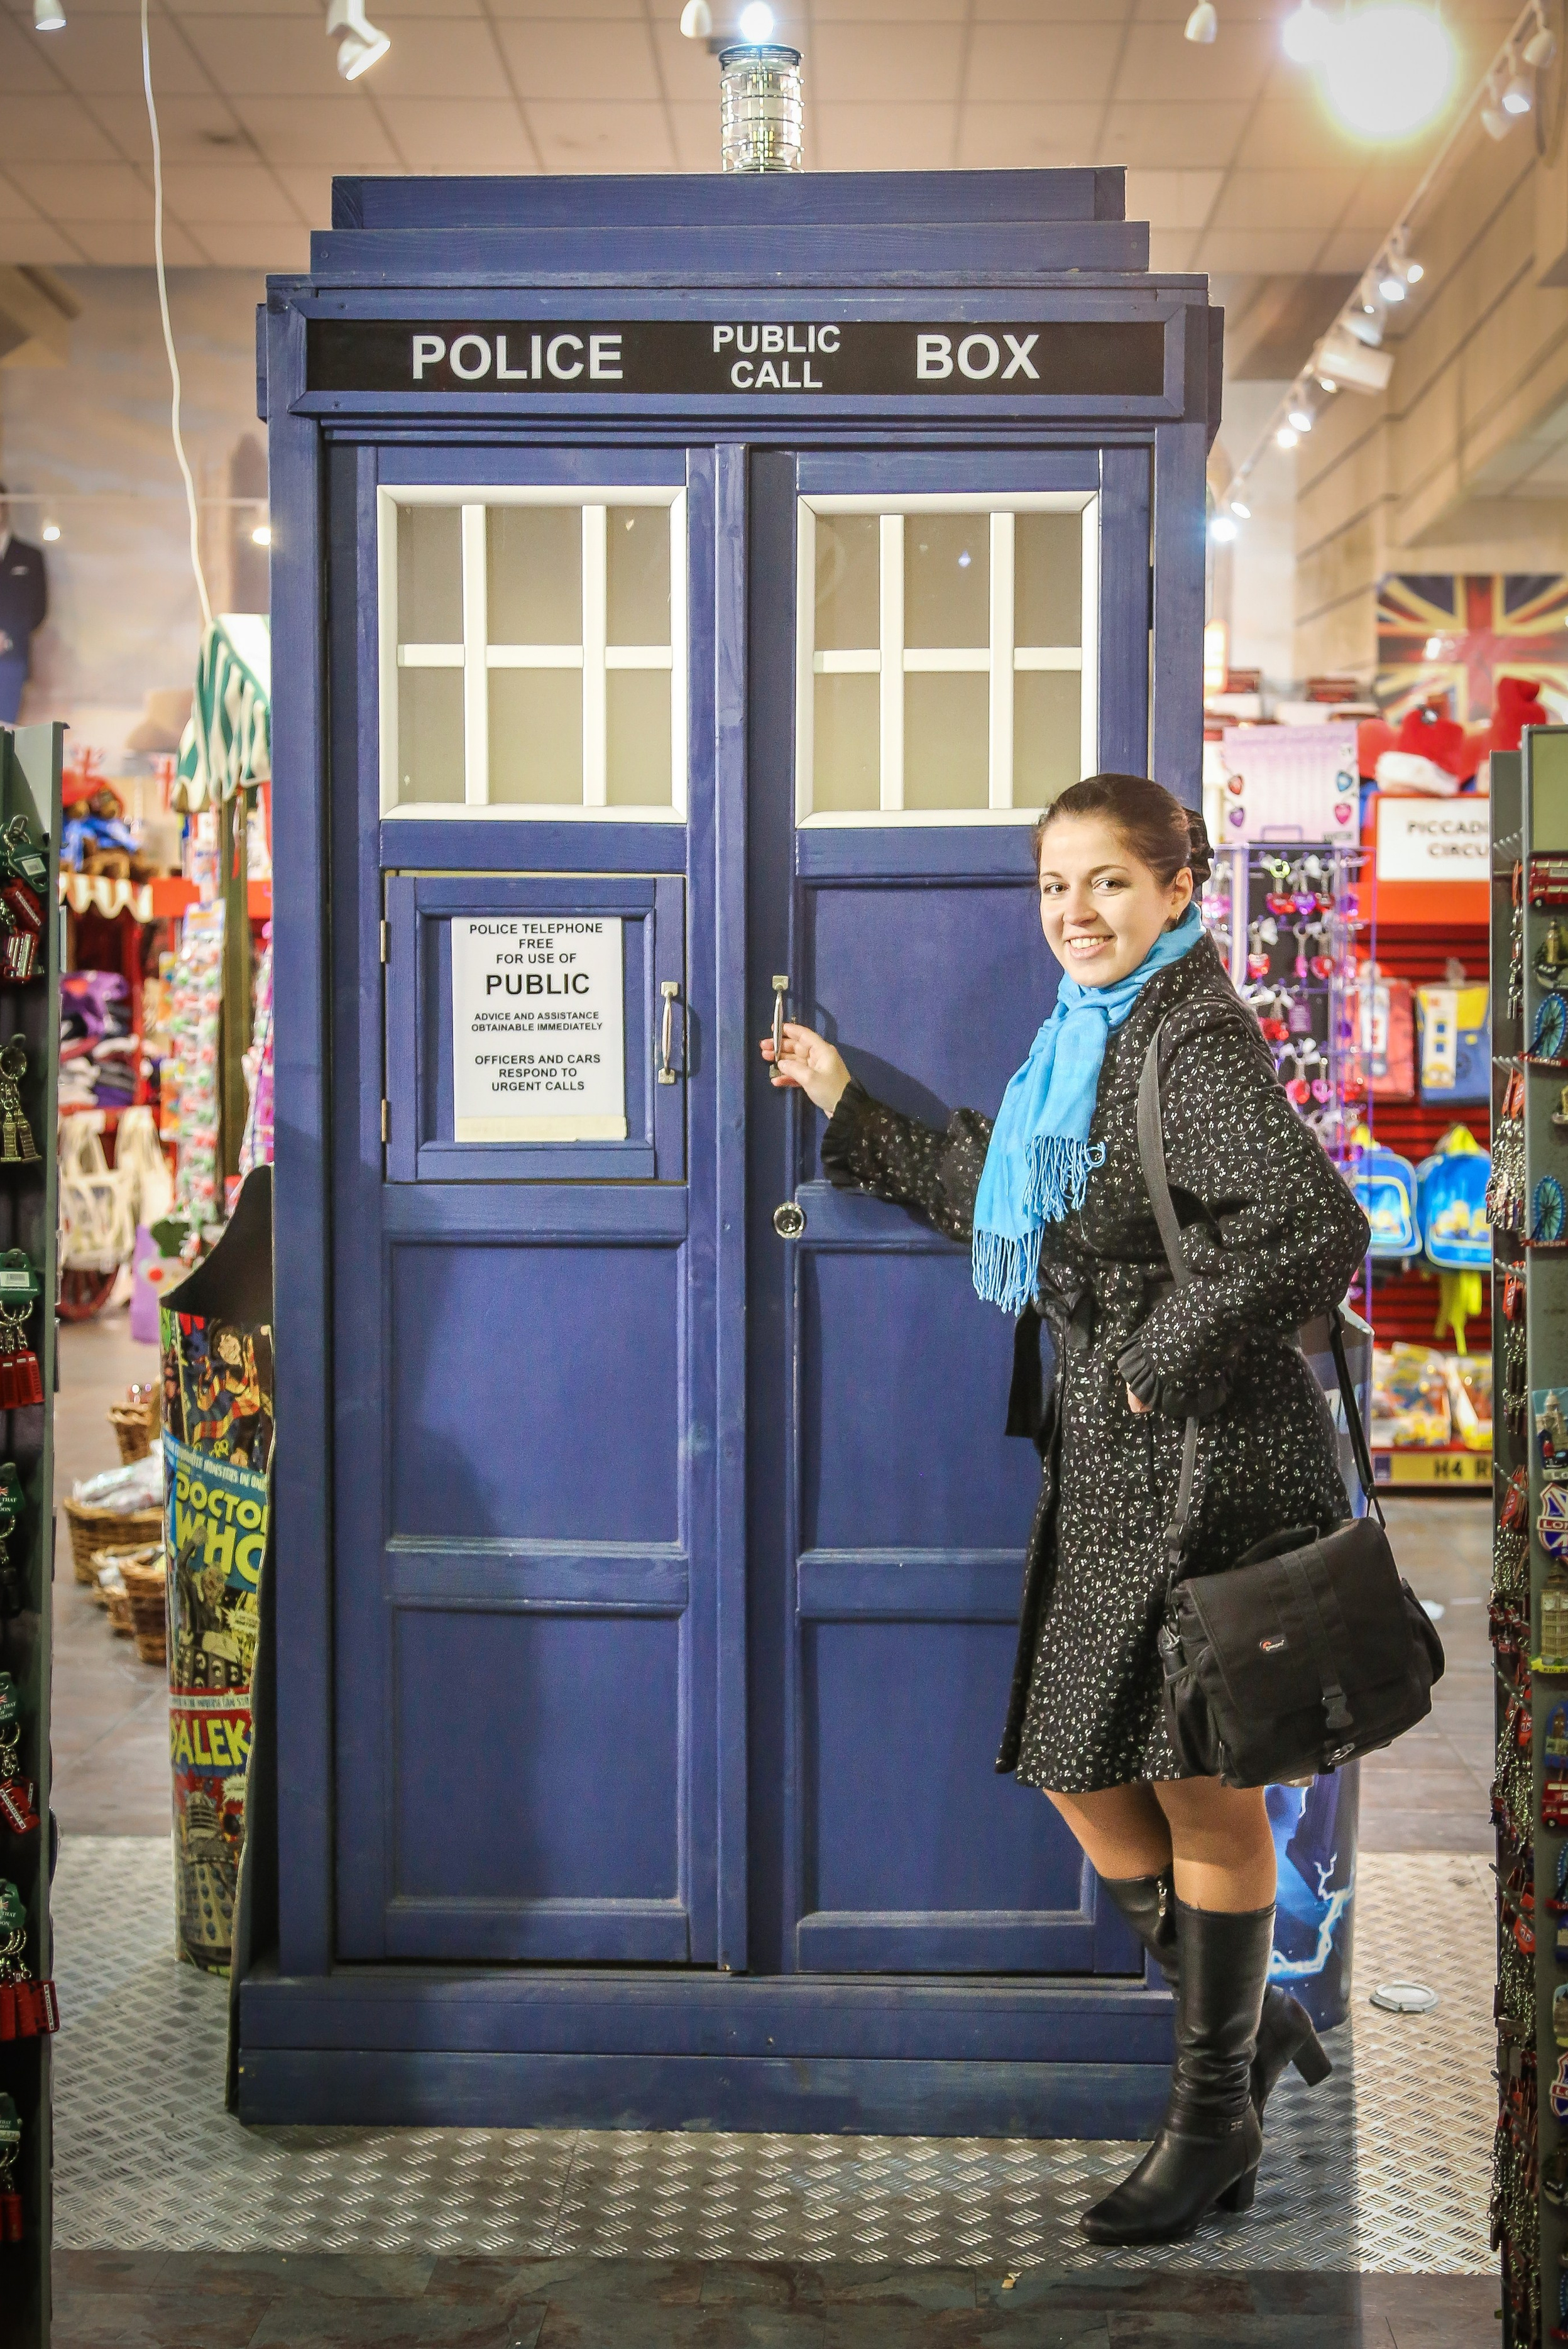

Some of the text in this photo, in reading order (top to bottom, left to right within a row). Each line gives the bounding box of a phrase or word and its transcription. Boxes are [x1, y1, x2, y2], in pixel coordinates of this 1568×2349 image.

[713, 325, 841, 353] PUBLIC
[412, 334, 623, 380] POLICE
[916, 334, 1040, 380] BOX
[730, 360, 823, 388] CALL
[469, 923, 603, 934] POLICE TELEPHONE
[519, 938, 553, 949] FREE
[496, 953, 576, 964] FOR USE OF
[486, 973, 589, 995] PUBLIC
[471, 1022, 603, 1032] OBTAINABLE IMMEDIATELY
[474, 1012, 511, 1021] ADVICE
[537, 1011, 598, 1020] ASSISTANCE
[474, 1054, 600, 1065] OFFICERS AND CARS
[499, 1068, 577, 1078] RESPOND TO
[491, 1081, 584, 1092] URGENT CALLS
[1476, 1459, 1493, 1477] R
[176, 1470, 268, 1533] DOCTO
[175, 1499, 266, 1584] WHO
[170, 1719, 252, 1766] DALEK
[3, 1795, 23, 1824] LONDON
[45, 1991, 54, 2025] LONDON
